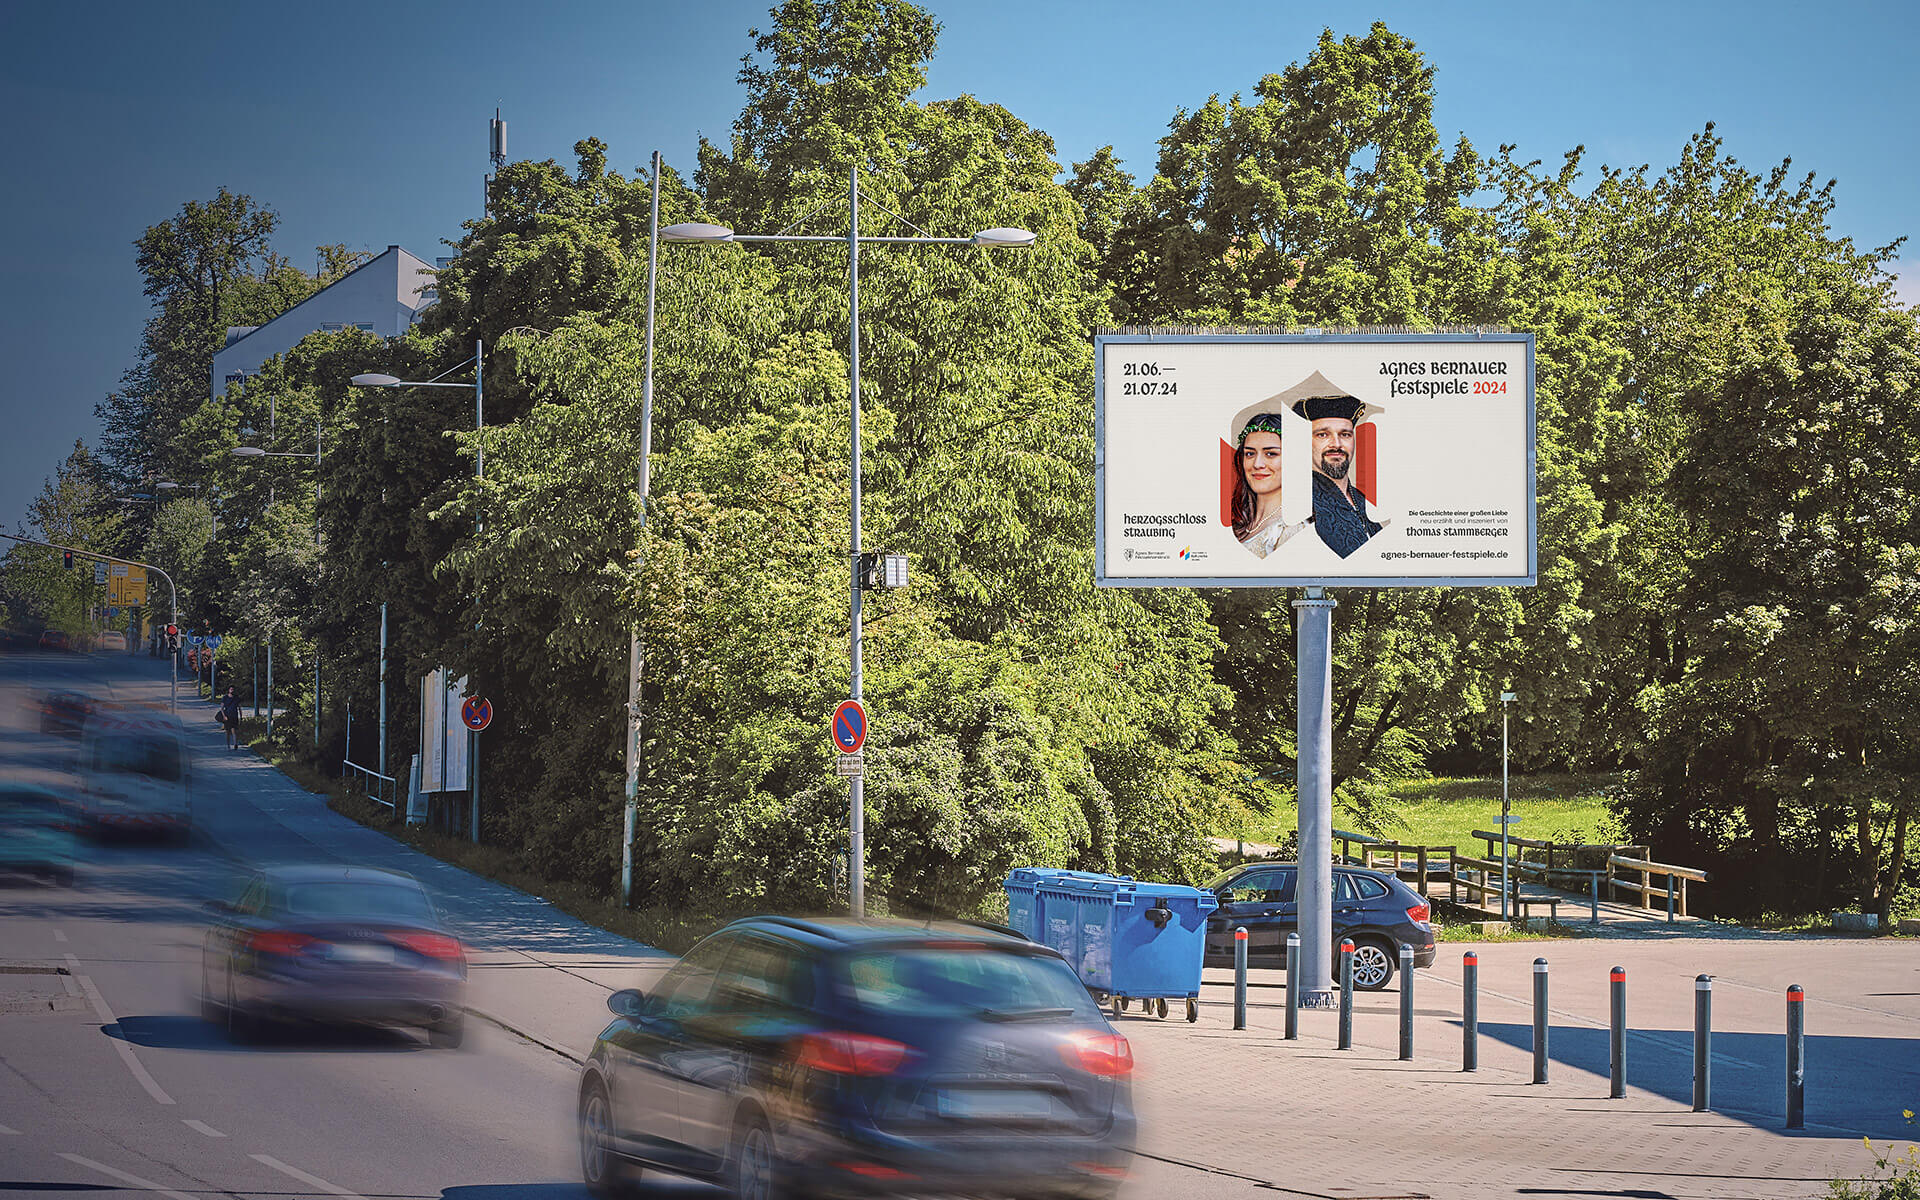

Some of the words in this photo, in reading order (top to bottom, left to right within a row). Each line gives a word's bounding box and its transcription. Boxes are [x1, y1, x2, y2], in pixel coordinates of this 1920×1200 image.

[1123, 382, 1177, 395] 21.07.24
[1473, 381, 1507, 394] 2024
[1380, 550, 1508, 560] agnes-bernauer-festspiele.de
